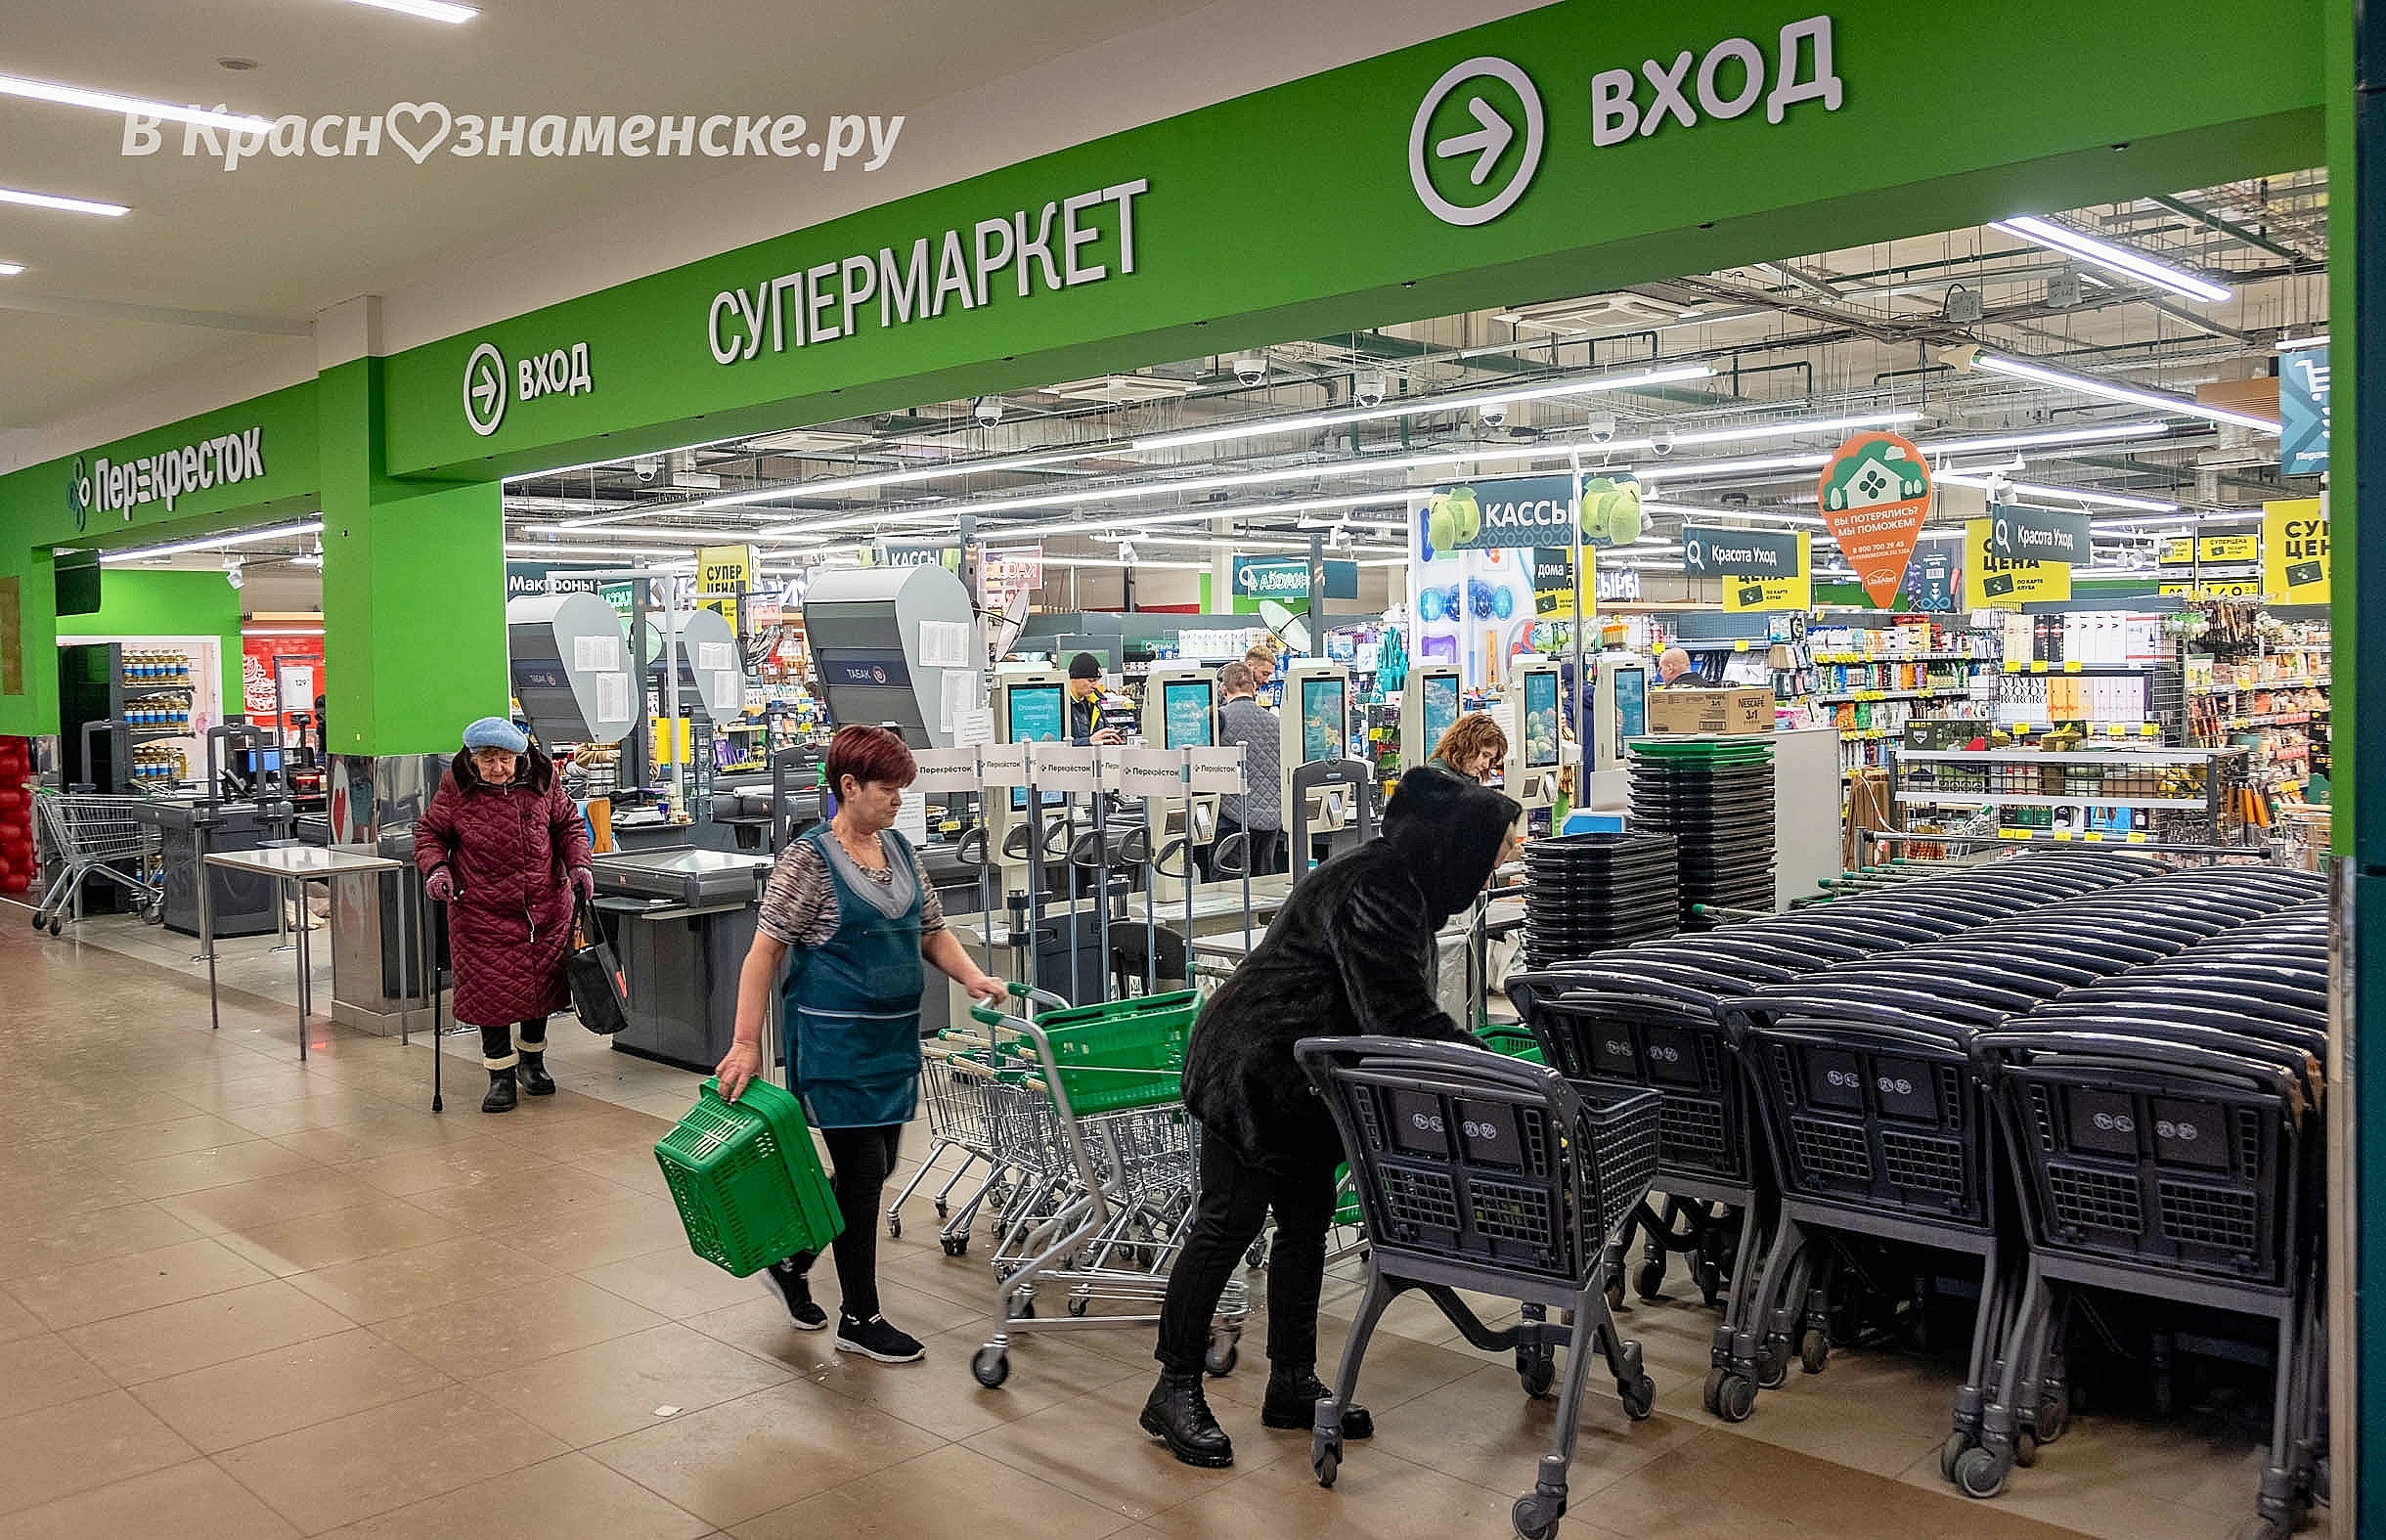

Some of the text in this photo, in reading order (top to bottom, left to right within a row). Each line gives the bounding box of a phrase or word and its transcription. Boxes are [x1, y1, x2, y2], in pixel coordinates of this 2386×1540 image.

[1591, 15, 1843, 148] ВХОД
[707, 178, 1150, 366] СУПЕРМАРКЕТ
[518, 342, 593, 401] ВХОД
[1484, 500, 1573, 529] КАССЫ
[1834, 506, 1920, 527] ВЫ ПОТЕРЯЛИСЬ?
[1837, 517, 1917, 537] МЫ ПОМОЖЕМ!
[2017, 524, 2052, 548] Красота
[2053, 528, 2074, 550] Уход
[891, 549, 941, 567] КАССЫ
[1711, 546, 1777, 567] Красота Уход
[706, 565, 743, 581] СУПЕР
[1537, 563, 1564, 579] дома
[509, 575, 596, 593] Макроны
